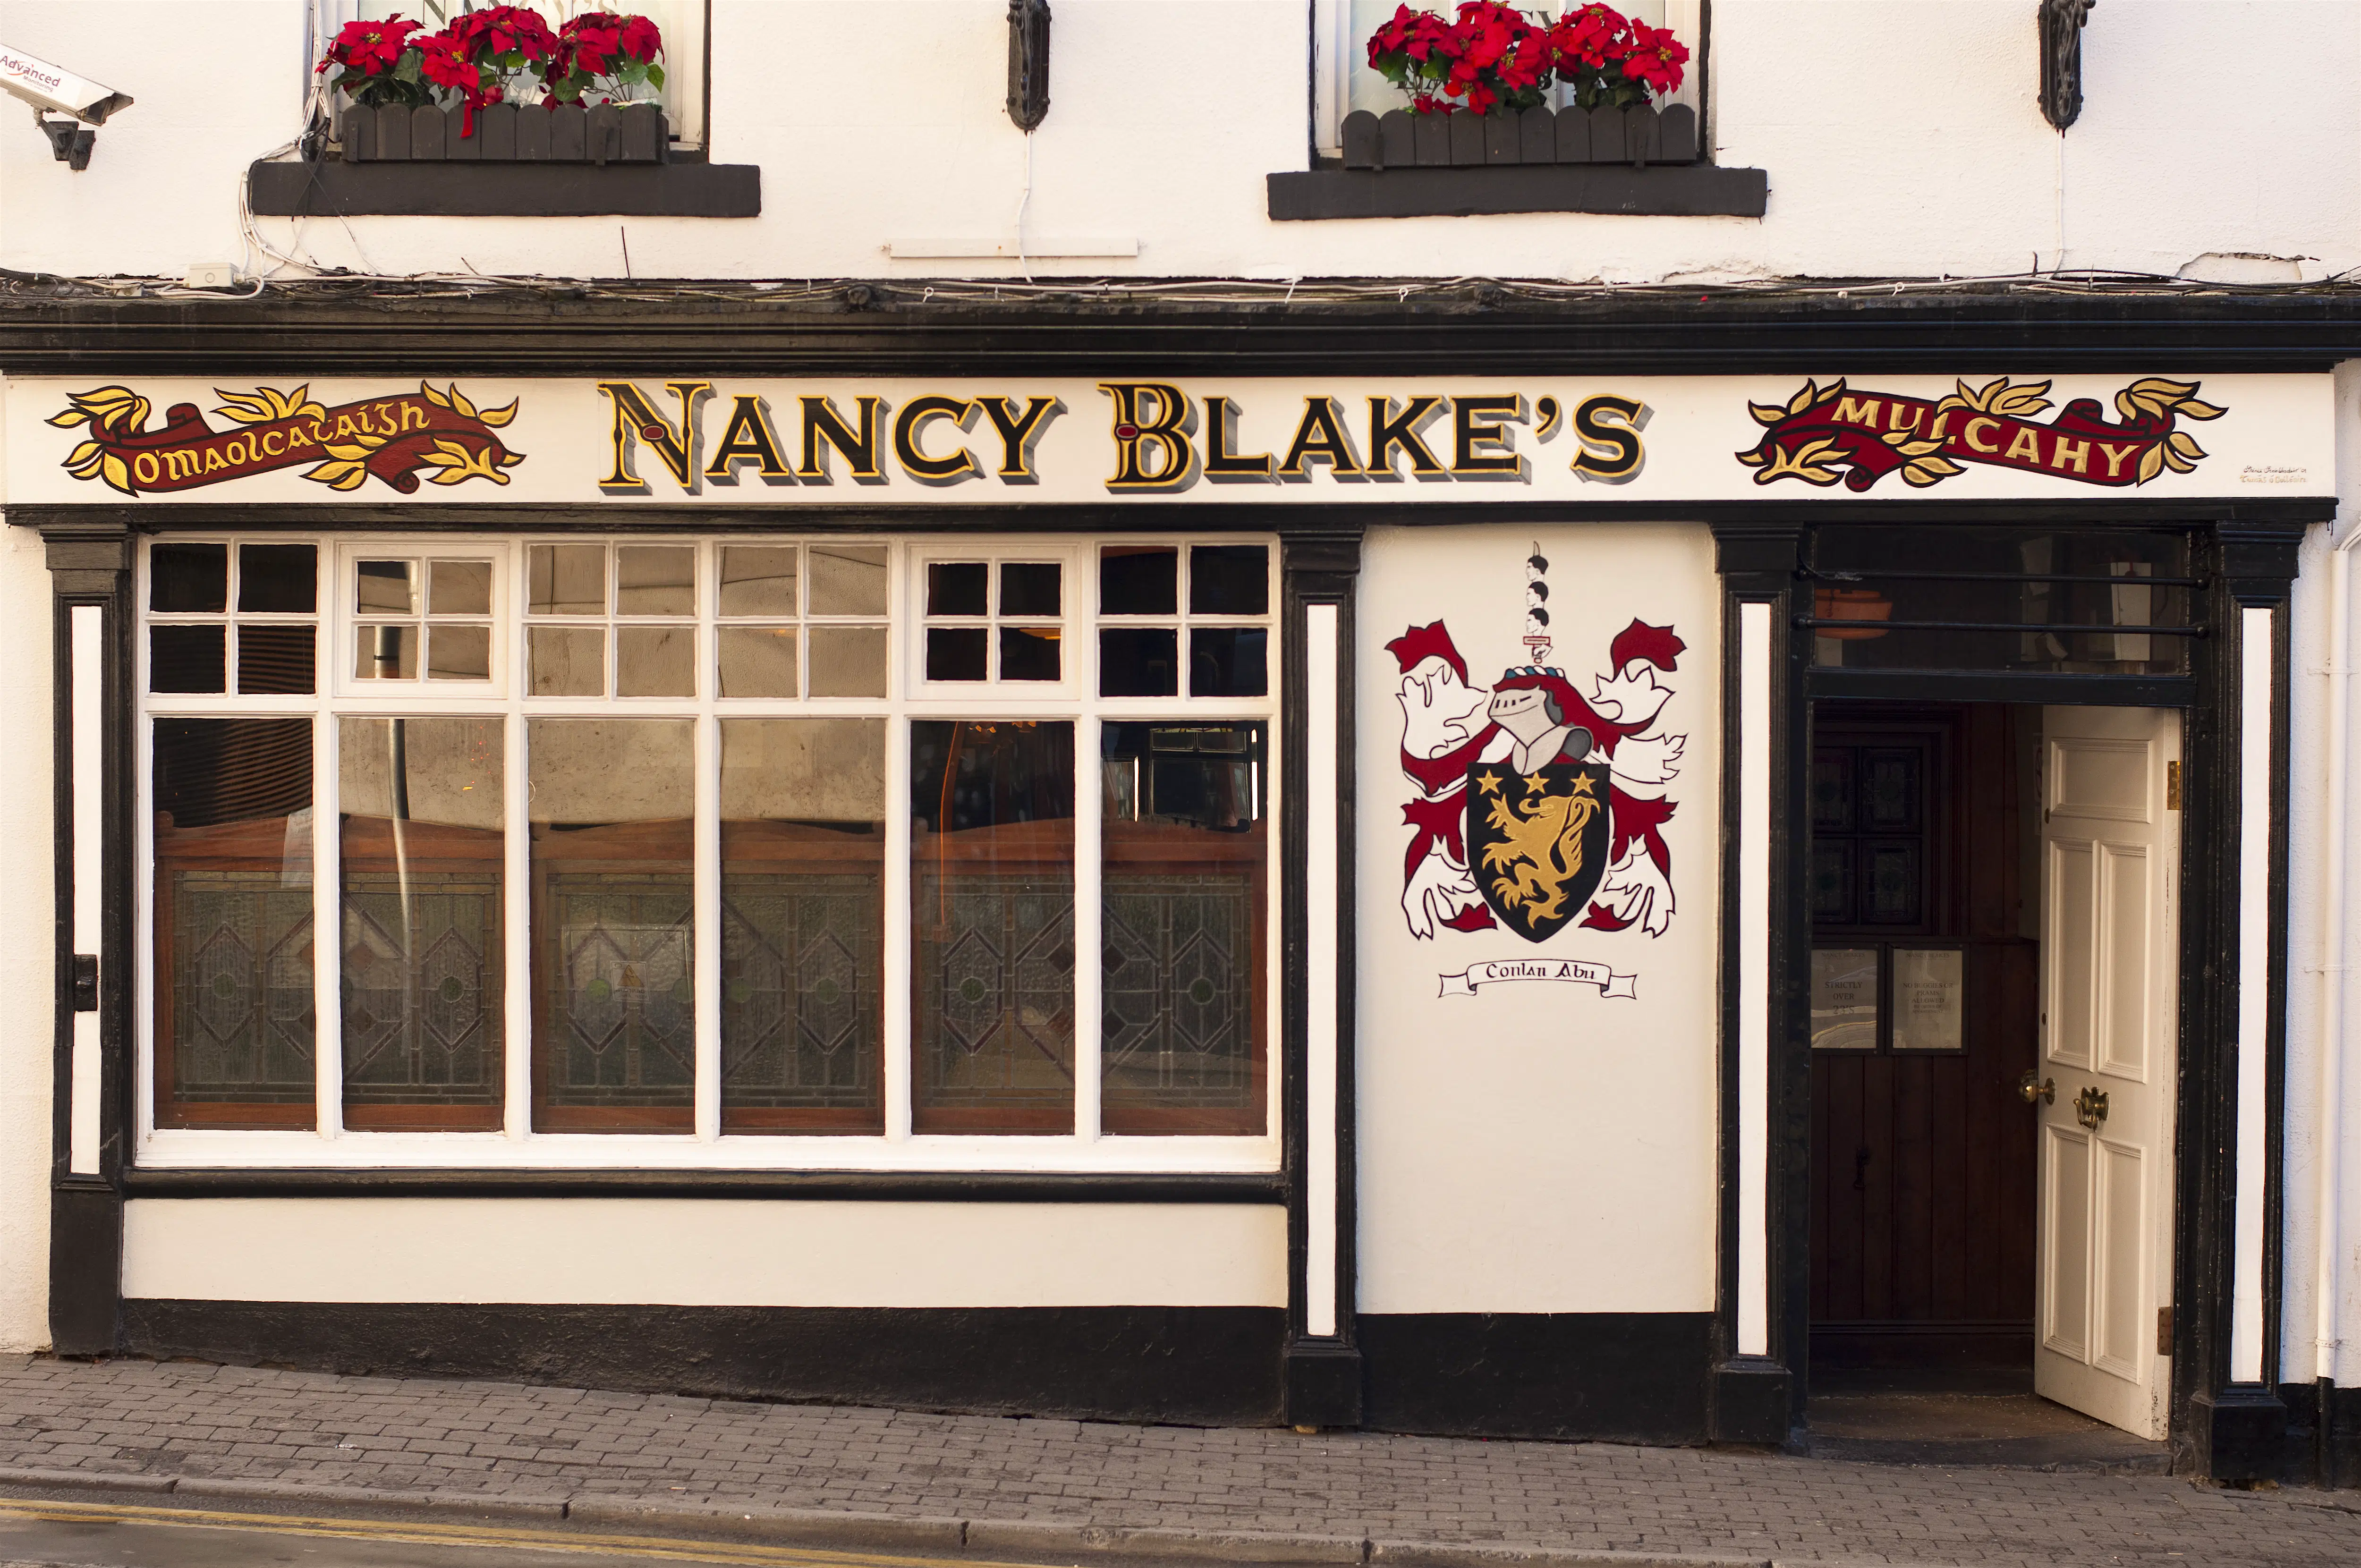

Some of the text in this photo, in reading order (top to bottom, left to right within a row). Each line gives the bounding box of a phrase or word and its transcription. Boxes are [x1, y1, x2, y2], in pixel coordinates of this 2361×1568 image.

[0, 56, 60, 87] Advanced
[597, 381, 1655, 496] NANCY BLAKE'S
[1830, 396, 2140, 477] MULCAHY
[1486, 962, 1596, 980] Conlan Abu
